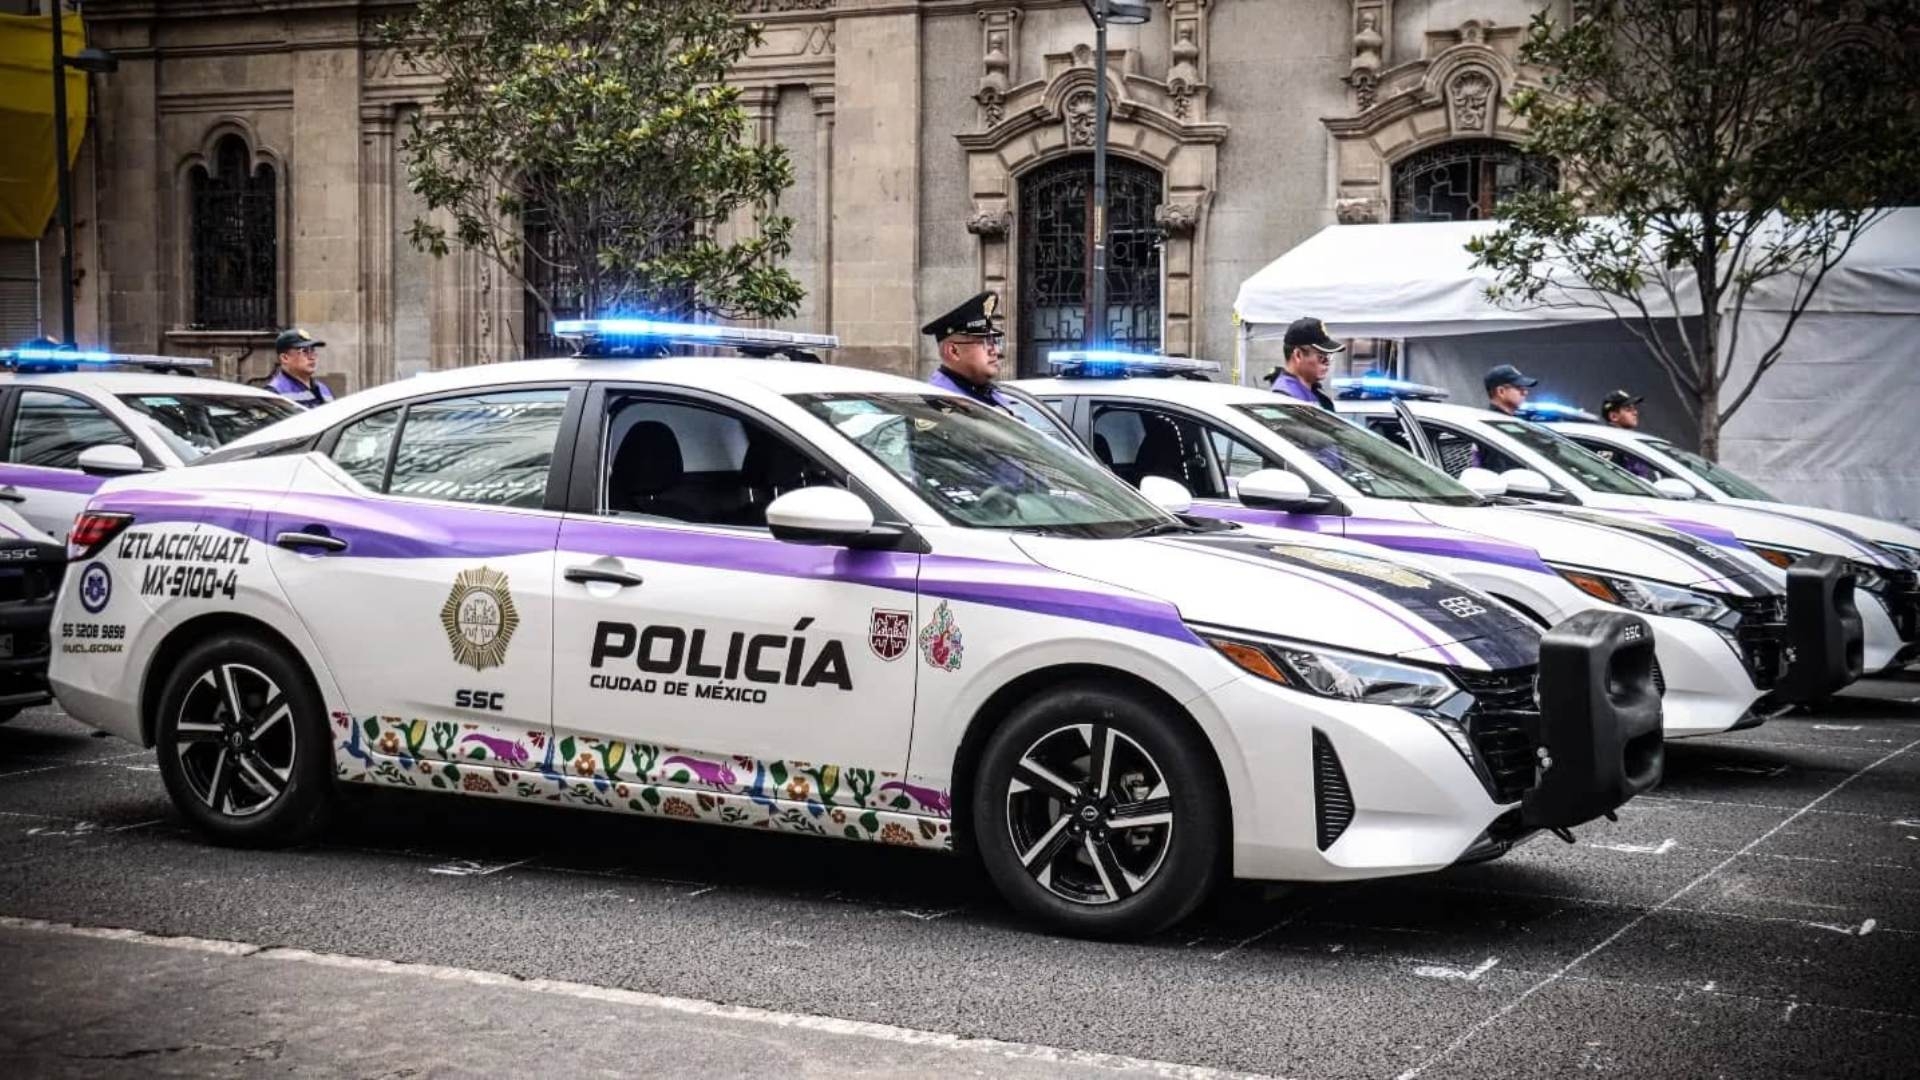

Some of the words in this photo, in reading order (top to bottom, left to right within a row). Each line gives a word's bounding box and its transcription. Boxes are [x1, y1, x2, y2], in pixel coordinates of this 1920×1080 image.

[118, 524, 251, 564] IZTLACCÍHUATL
[140, 565, 238, 600] MX-9100-4
[591, 617, 854, 691] POLICÍA
[455, 689, 504, 711] SSC
[590, 675, 657, 694] CIUDAD
[664, 681, 689, 697] DE
[695, 680, 767, 704] MÉXICO
